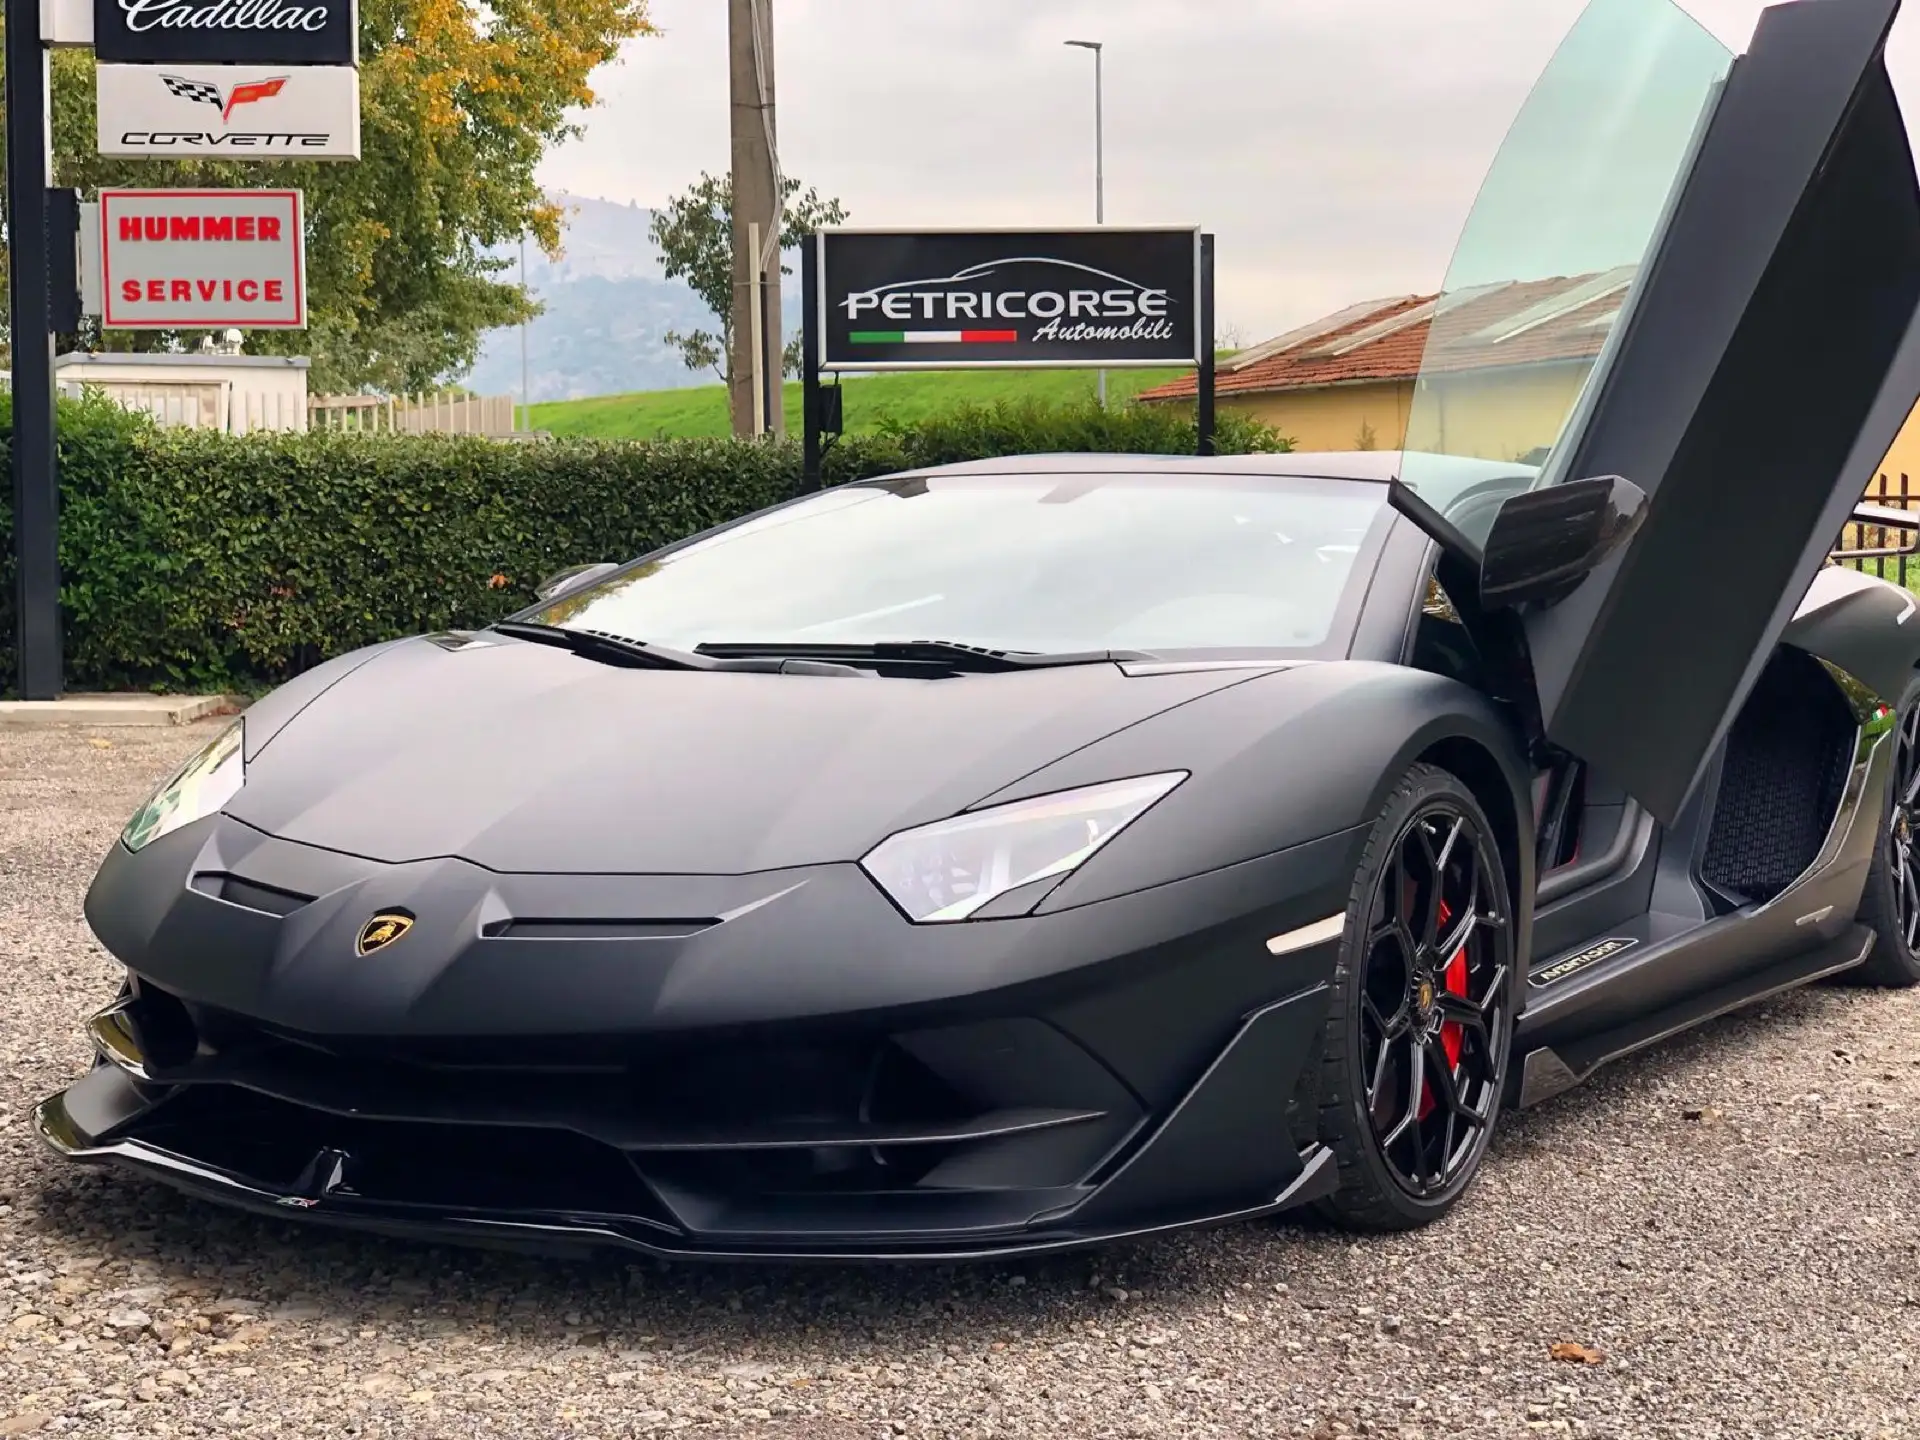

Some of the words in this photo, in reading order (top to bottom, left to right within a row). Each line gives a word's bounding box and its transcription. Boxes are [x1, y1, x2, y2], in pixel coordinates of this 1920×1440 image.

[118, 0, 327, 31] Cadillac
[121, 132, 330, 146] CORVETTE
[119, 217, 281, 241] HUMMER
[122, 280, 283, 302] SERVICE
[847, 289, 1168, 320] PETRICORSE
[1032, 316, 1173, 342] Automobili
